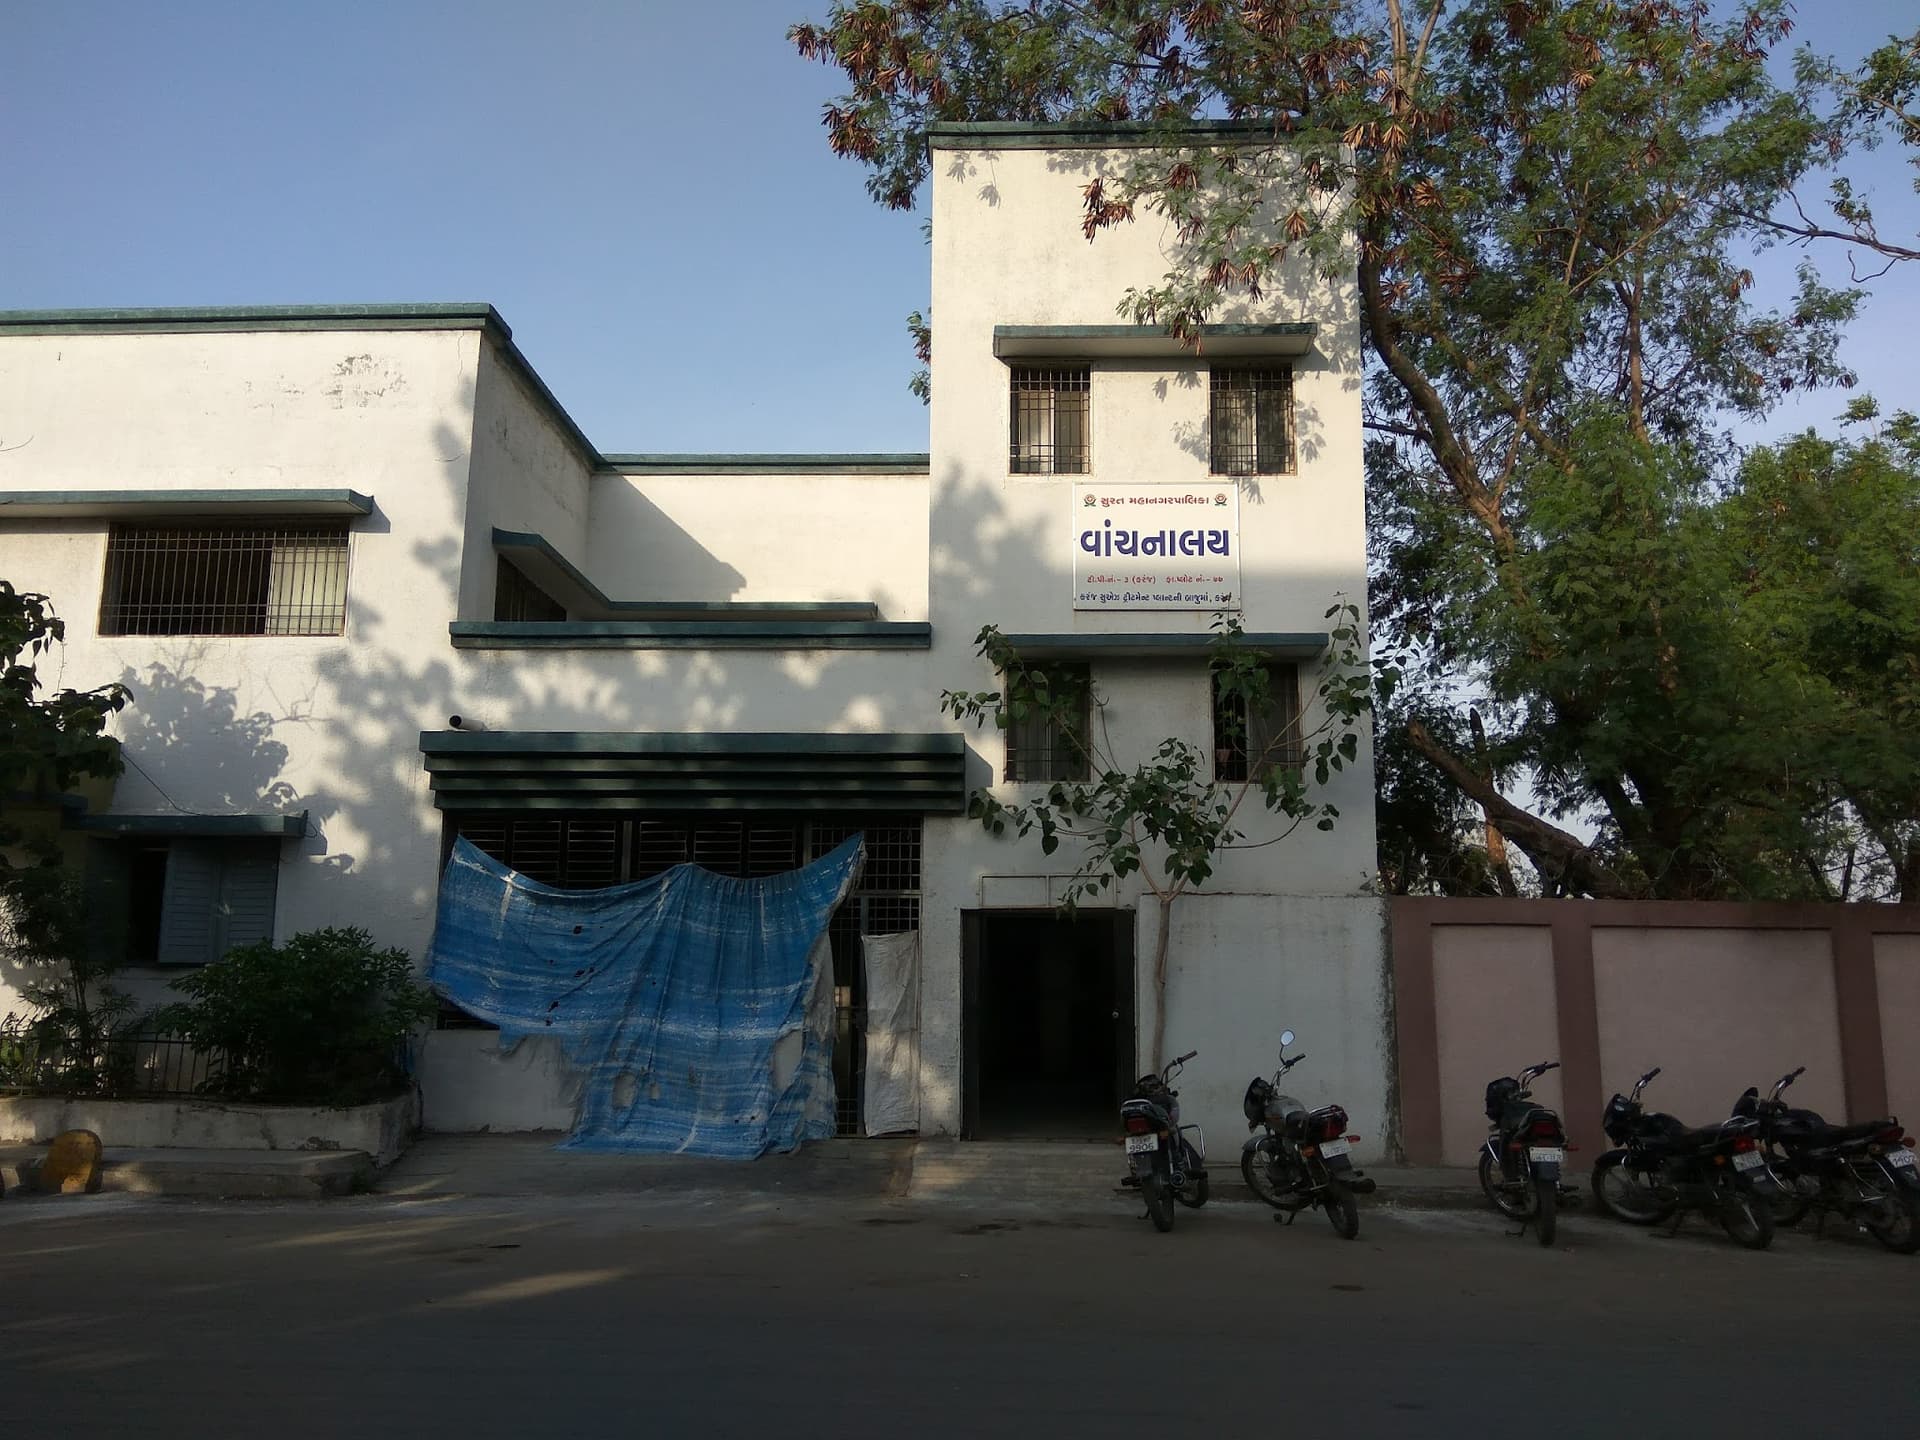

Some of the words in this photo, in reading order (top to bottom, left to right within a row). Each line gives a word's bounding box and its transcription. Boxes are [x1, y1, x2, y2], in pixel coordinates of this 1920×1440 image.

[1100, 496, 1124, 507] સુરત
[1129, 494, 1209, 505] મહાનગરપાલિકા
[1080, 518, 1230, 557] વાંચનાલય
[1080, 591, 1097, 601] કરંજ
